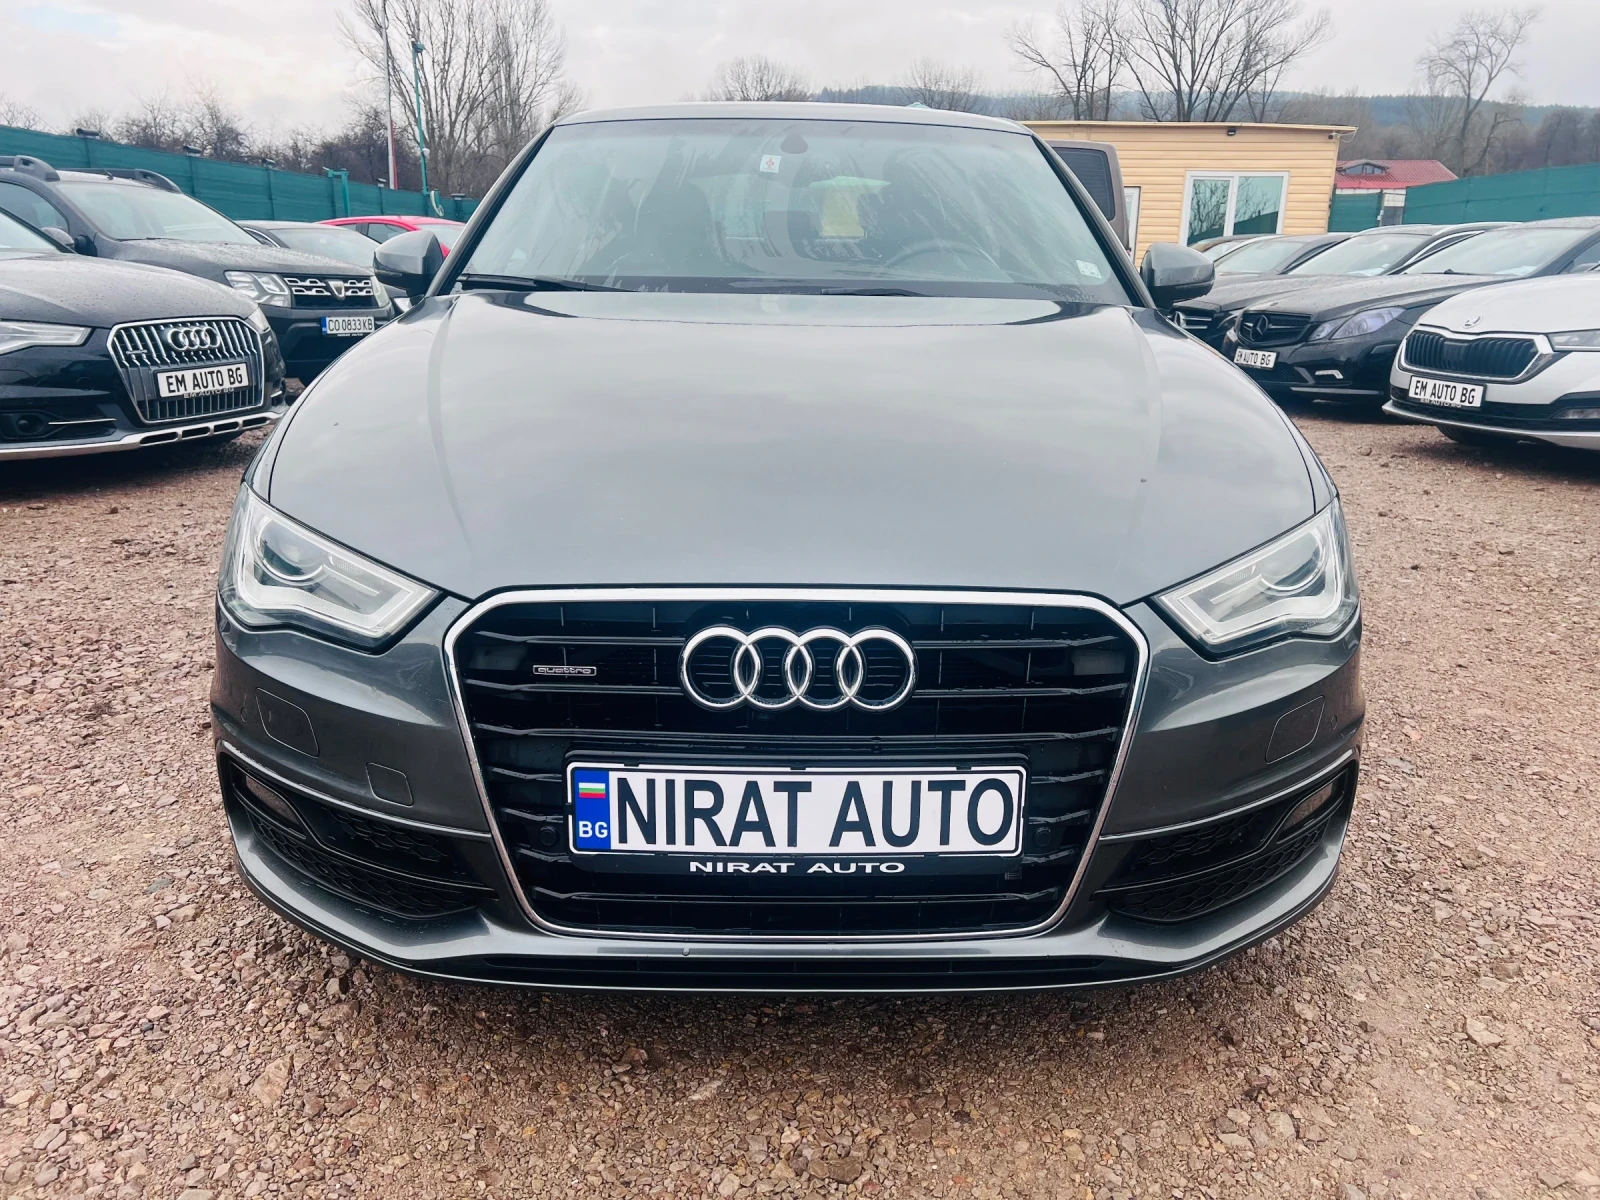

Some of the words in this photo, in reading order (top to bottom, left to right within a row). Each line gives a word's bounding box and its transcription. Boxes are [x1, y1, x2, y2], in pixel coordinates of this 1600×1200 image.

[1244, 352, 1258, 364] AUTO
[1260, 354, 1271, 366] BG
[166, 374, 187, 394] EM
[192, 370, 224, 392] AUTO
[227, 367, 243, 386] BG
[198, 388, 222, 396] AUTO
[1414, 380, 1428, 396] EM
[1430, 383, 1456, 402] AUTO
[1460, 387, 1476, 404] BG
[617, 777, 812, 848] NIRAT
[828, 778, 1014, 848] AUTO
[578, 820, 608, 838] BG
[690, 862, 796, 874] NIRAT
[806, 862, 906, 874] AUTO
